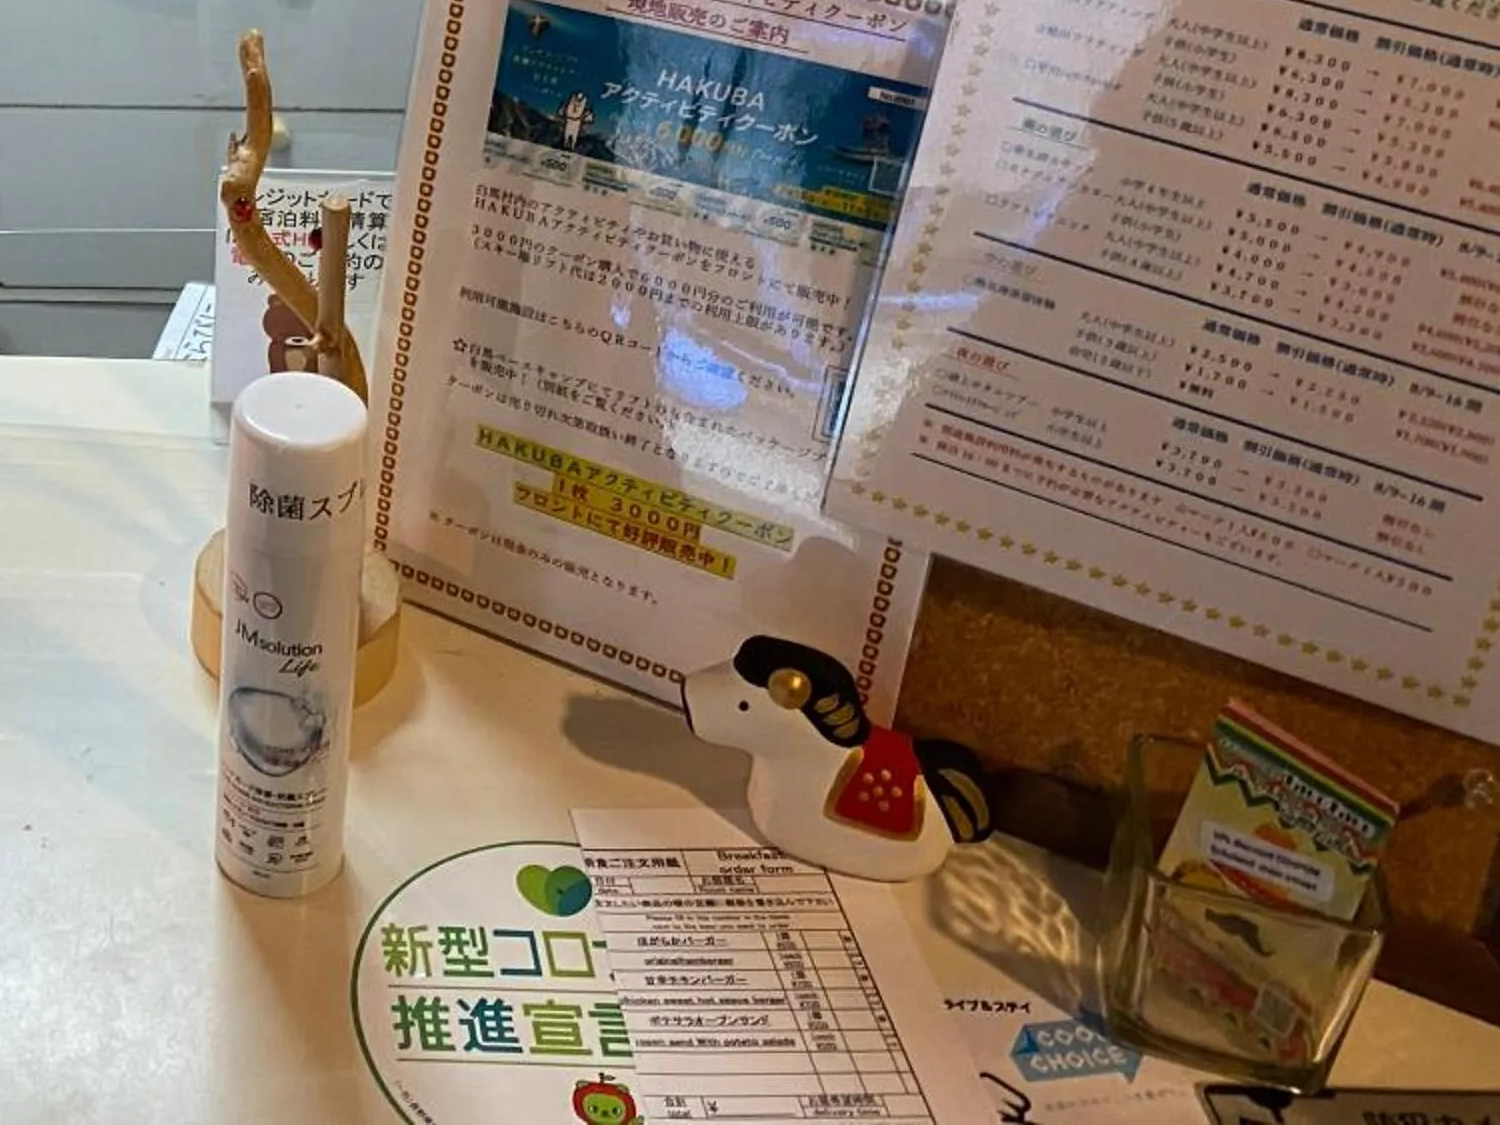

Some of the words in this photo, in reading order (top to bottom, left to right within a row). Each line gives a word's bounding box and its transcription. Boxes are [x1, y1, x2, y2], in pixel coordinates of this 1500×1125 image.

[656, 69, 766, 110] HAKUBA
[601, 81, 819, 146] アクティビティクーポン
[477, 427, 794, 545] HAKUBAアクティビティクーポン
[234, 617, 324, 657] JMsolution
[278, 656, 322, 678] Life
[380, 922, 606, 979] 新型コロ
[391, 994, 634, 1059] 推進宣言
[1034, 1022, 1104, 1048] COO
[1029, 1045, 1129, 1075] CHOICE
